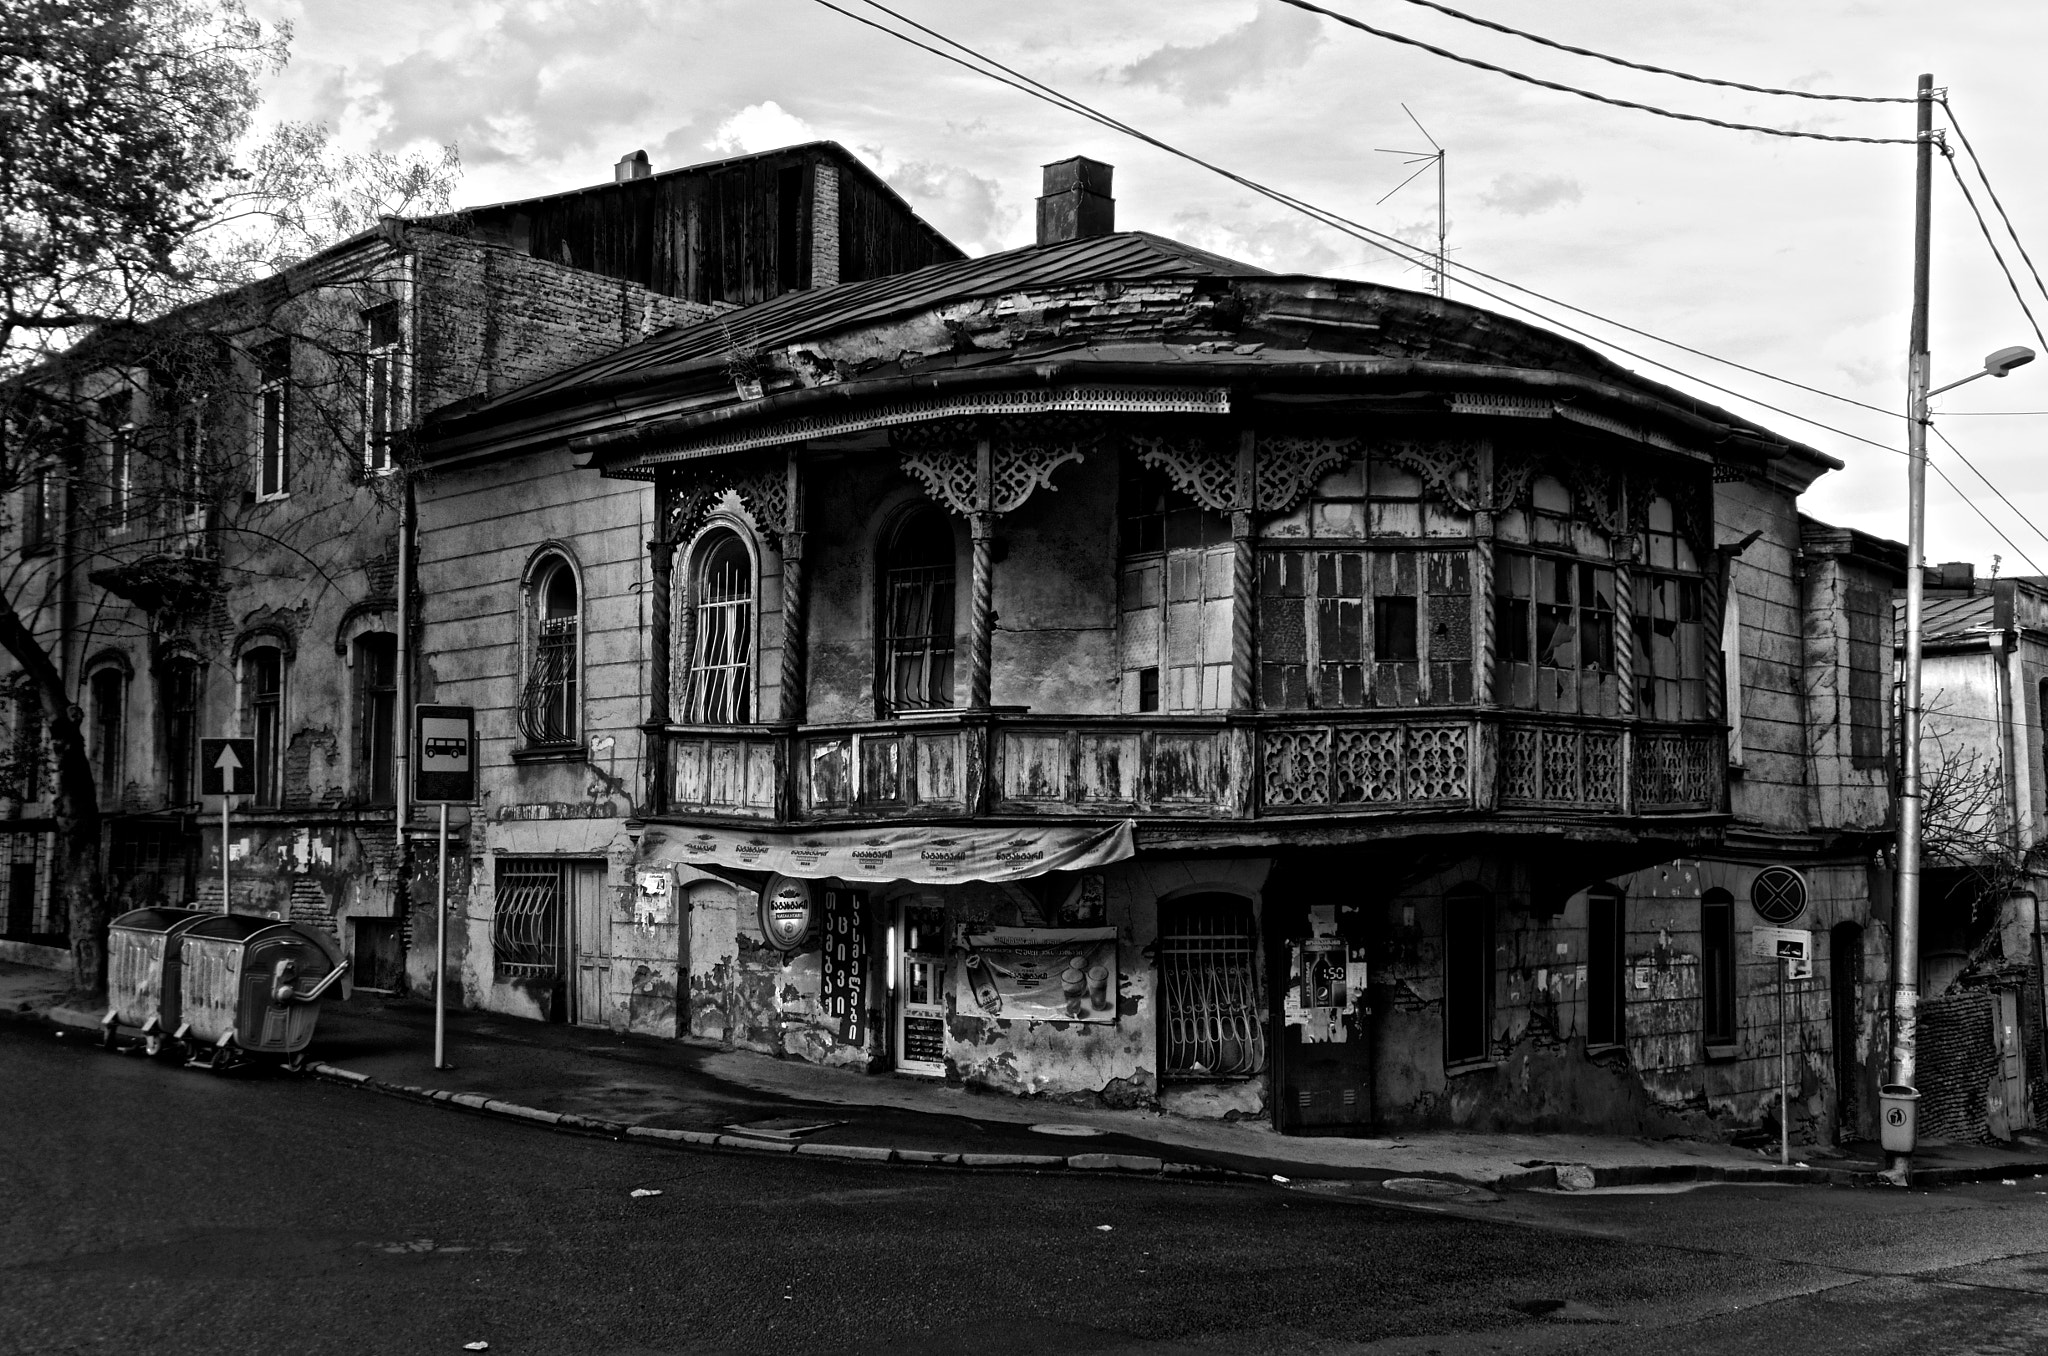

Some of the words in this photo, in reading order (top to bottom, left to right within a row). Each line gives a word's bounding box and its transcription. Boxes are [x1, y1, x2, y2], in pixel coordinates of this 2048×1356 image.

[852, 849, 893, 859] ნატახტარი
[921, 850, 966, 861] ნატახტარი
[996, 850, 1044, 861] ნატახტარი
[771, 899, 808, 911] ნატახტარი
[849, 894, 861, 1040] სასმელები
